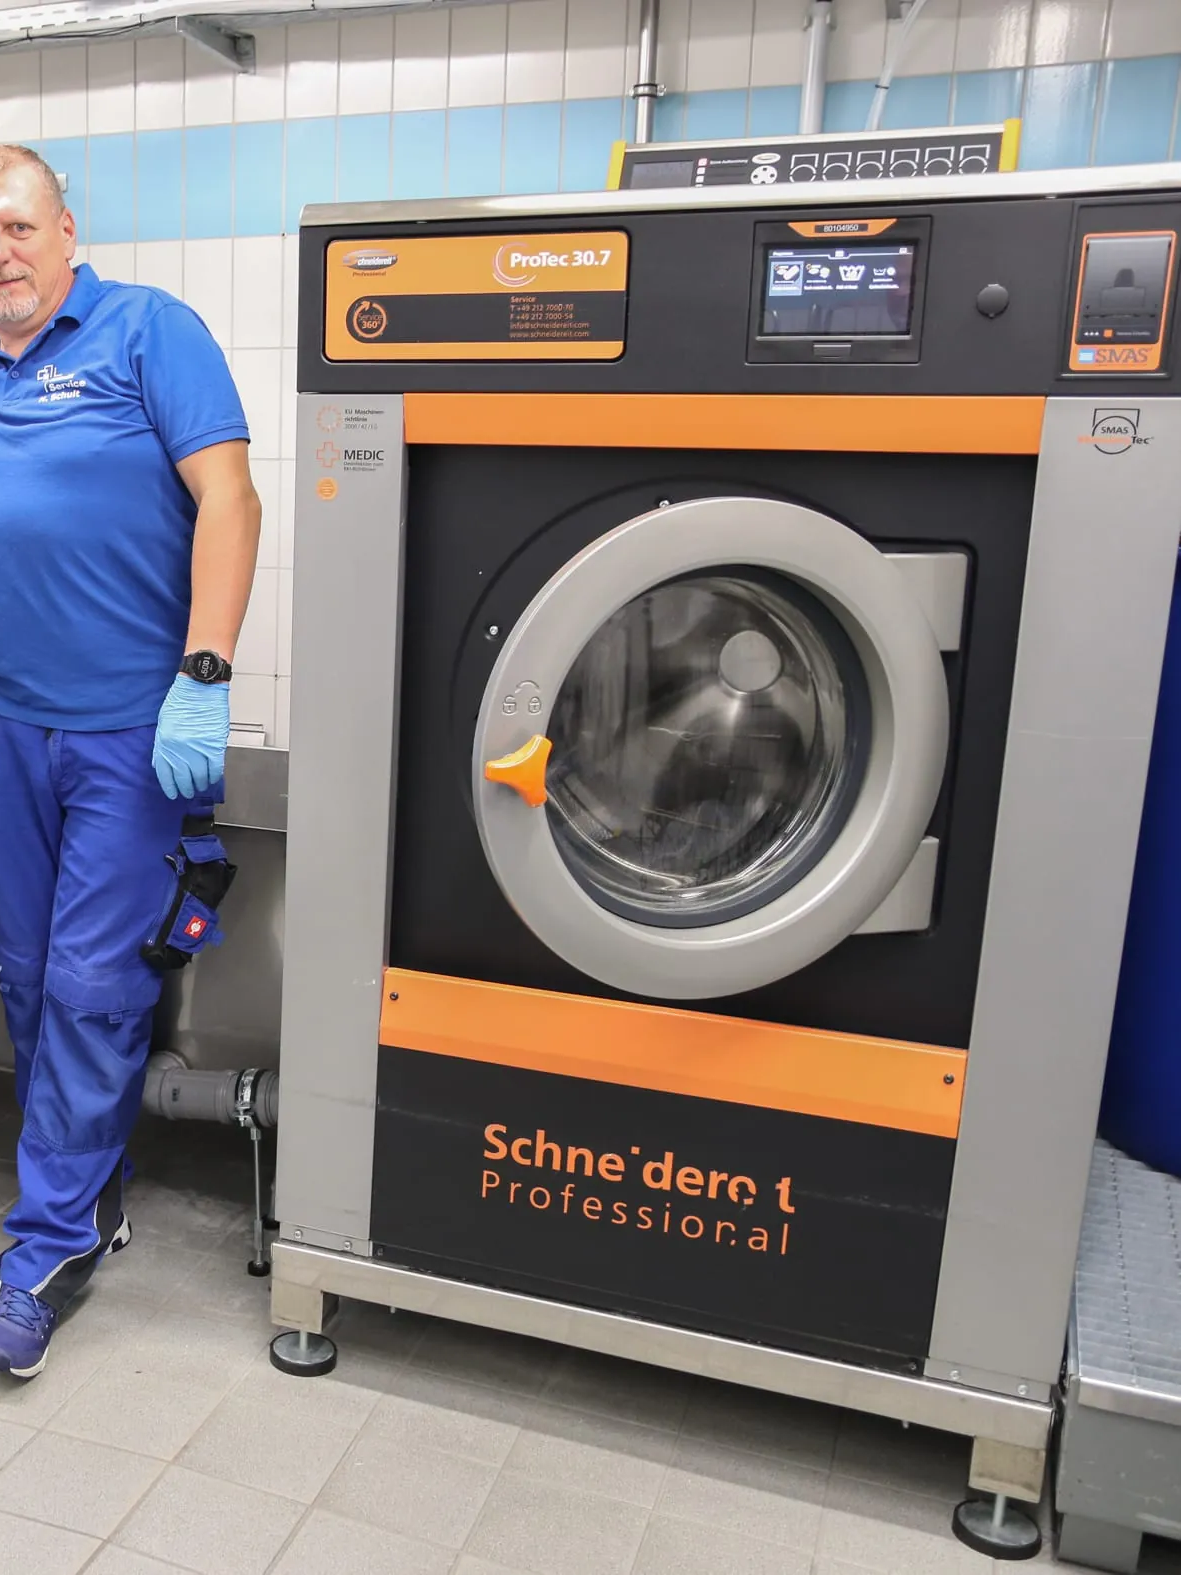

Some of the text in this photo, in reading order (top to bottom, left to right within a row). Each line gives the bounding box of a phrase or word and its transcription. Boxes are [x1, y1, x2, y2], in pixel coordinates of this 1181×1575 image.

[510, 250, 611, 268] ProTec 30.7
[359, 312, 382, 321] Service
[1095, 348, 1149, 363] SMAS
[49, 380, 86, 391] Service
[1101, 426, 1128, 434] SMAS
[344, 450, 384, 460] MEDIC
